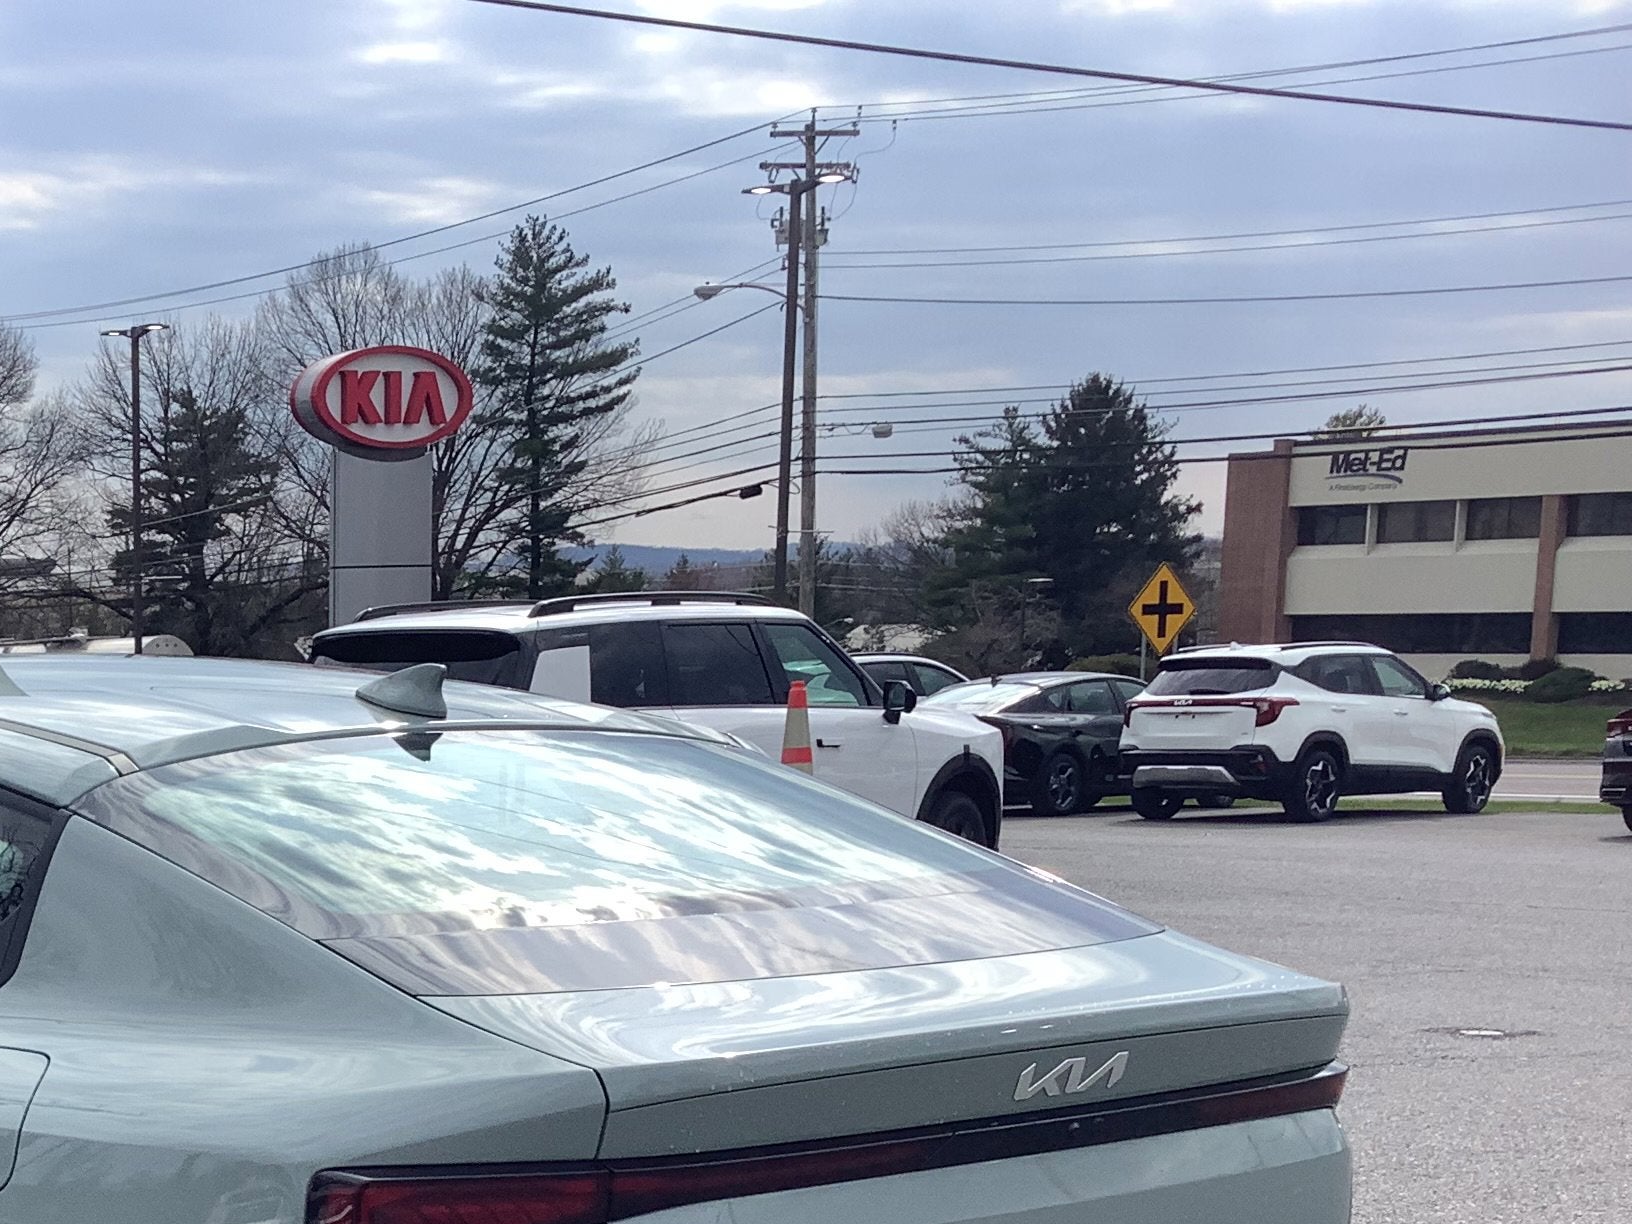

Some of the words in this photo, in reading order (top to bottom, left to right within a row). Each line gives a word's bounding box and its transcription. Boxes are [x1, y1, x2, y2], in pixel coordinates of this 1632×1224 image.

[339, 370, 447, 425] KIA
[1329, 447, 1409, 474] Met-Ed
[1013, 1050, 1129, 1101] KIA
